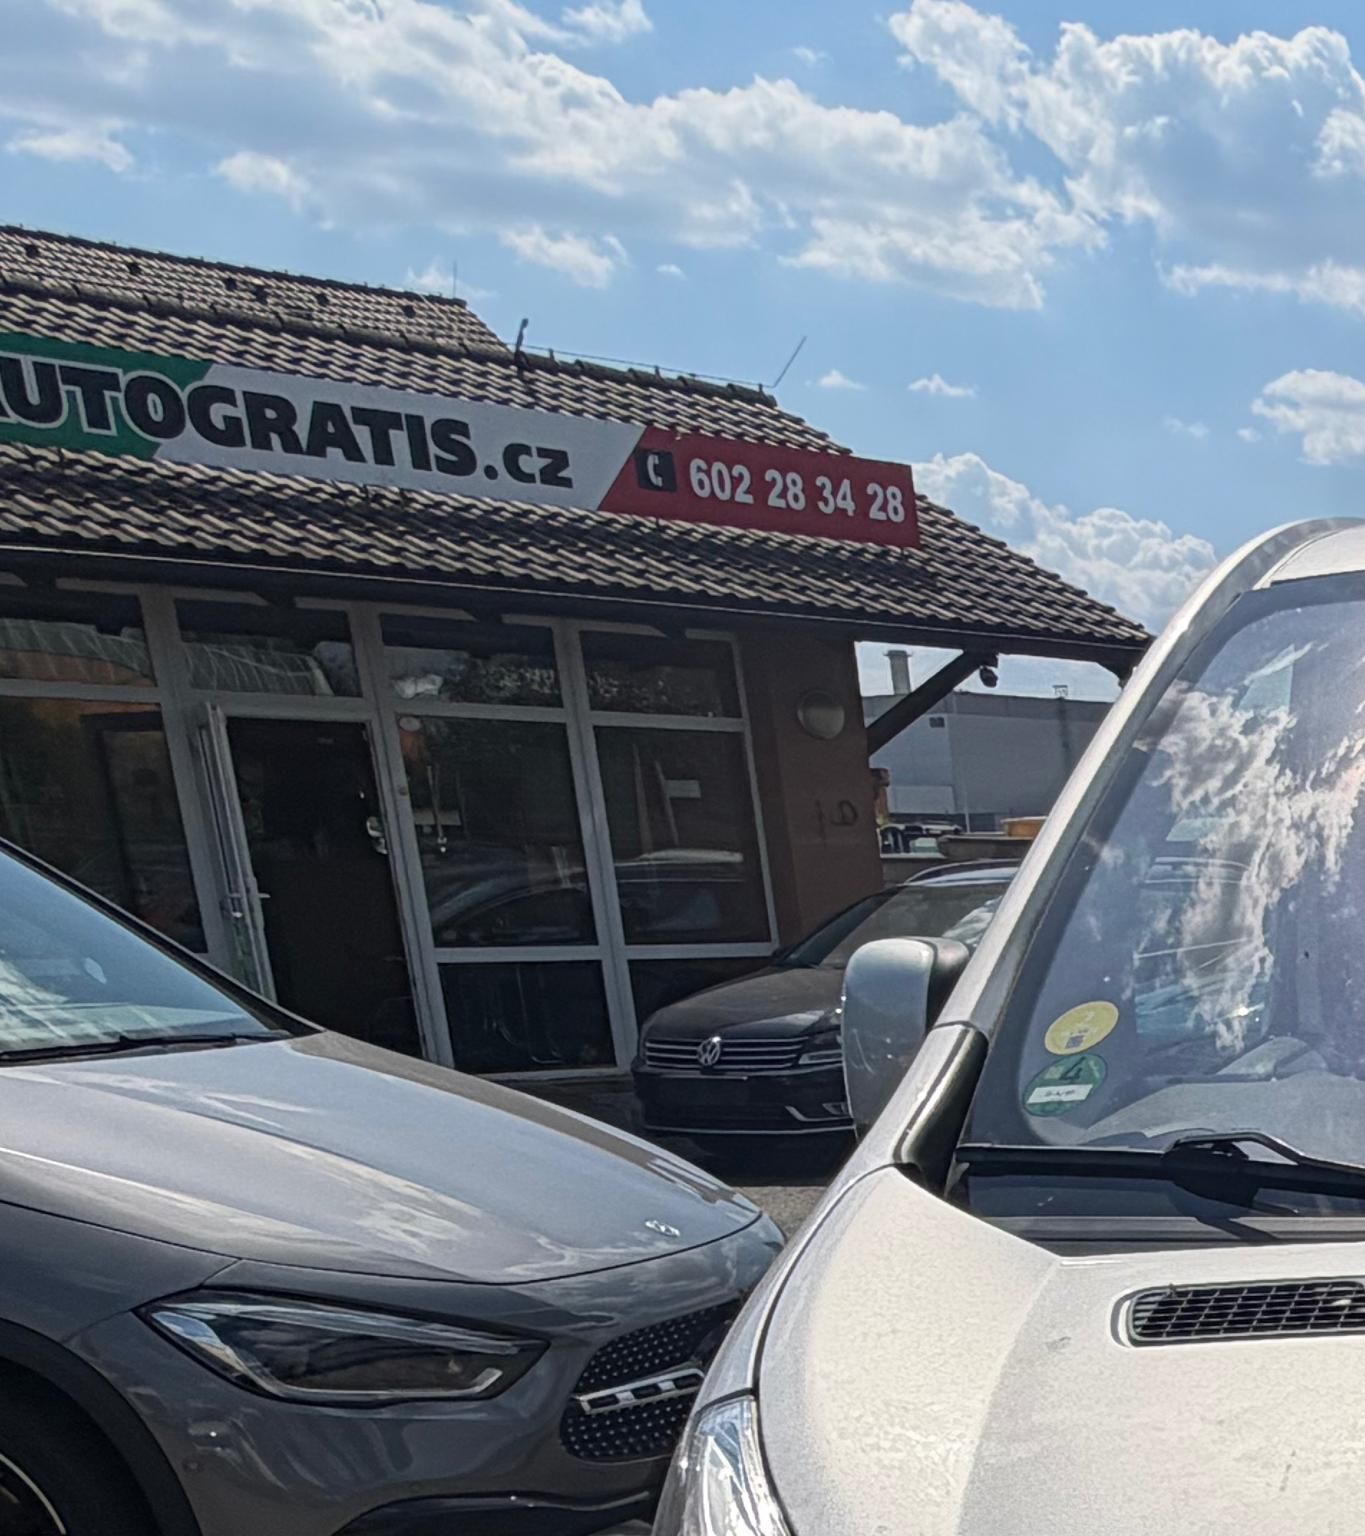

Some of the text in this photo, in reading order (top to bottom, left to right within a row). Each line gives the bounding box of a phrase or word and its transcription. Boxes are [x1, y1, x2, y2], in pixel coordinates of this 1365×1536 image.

[0, 354, 573, 489] UTOGRATIS.cz
[690, 458, 905, 523] 602 28 34 28
